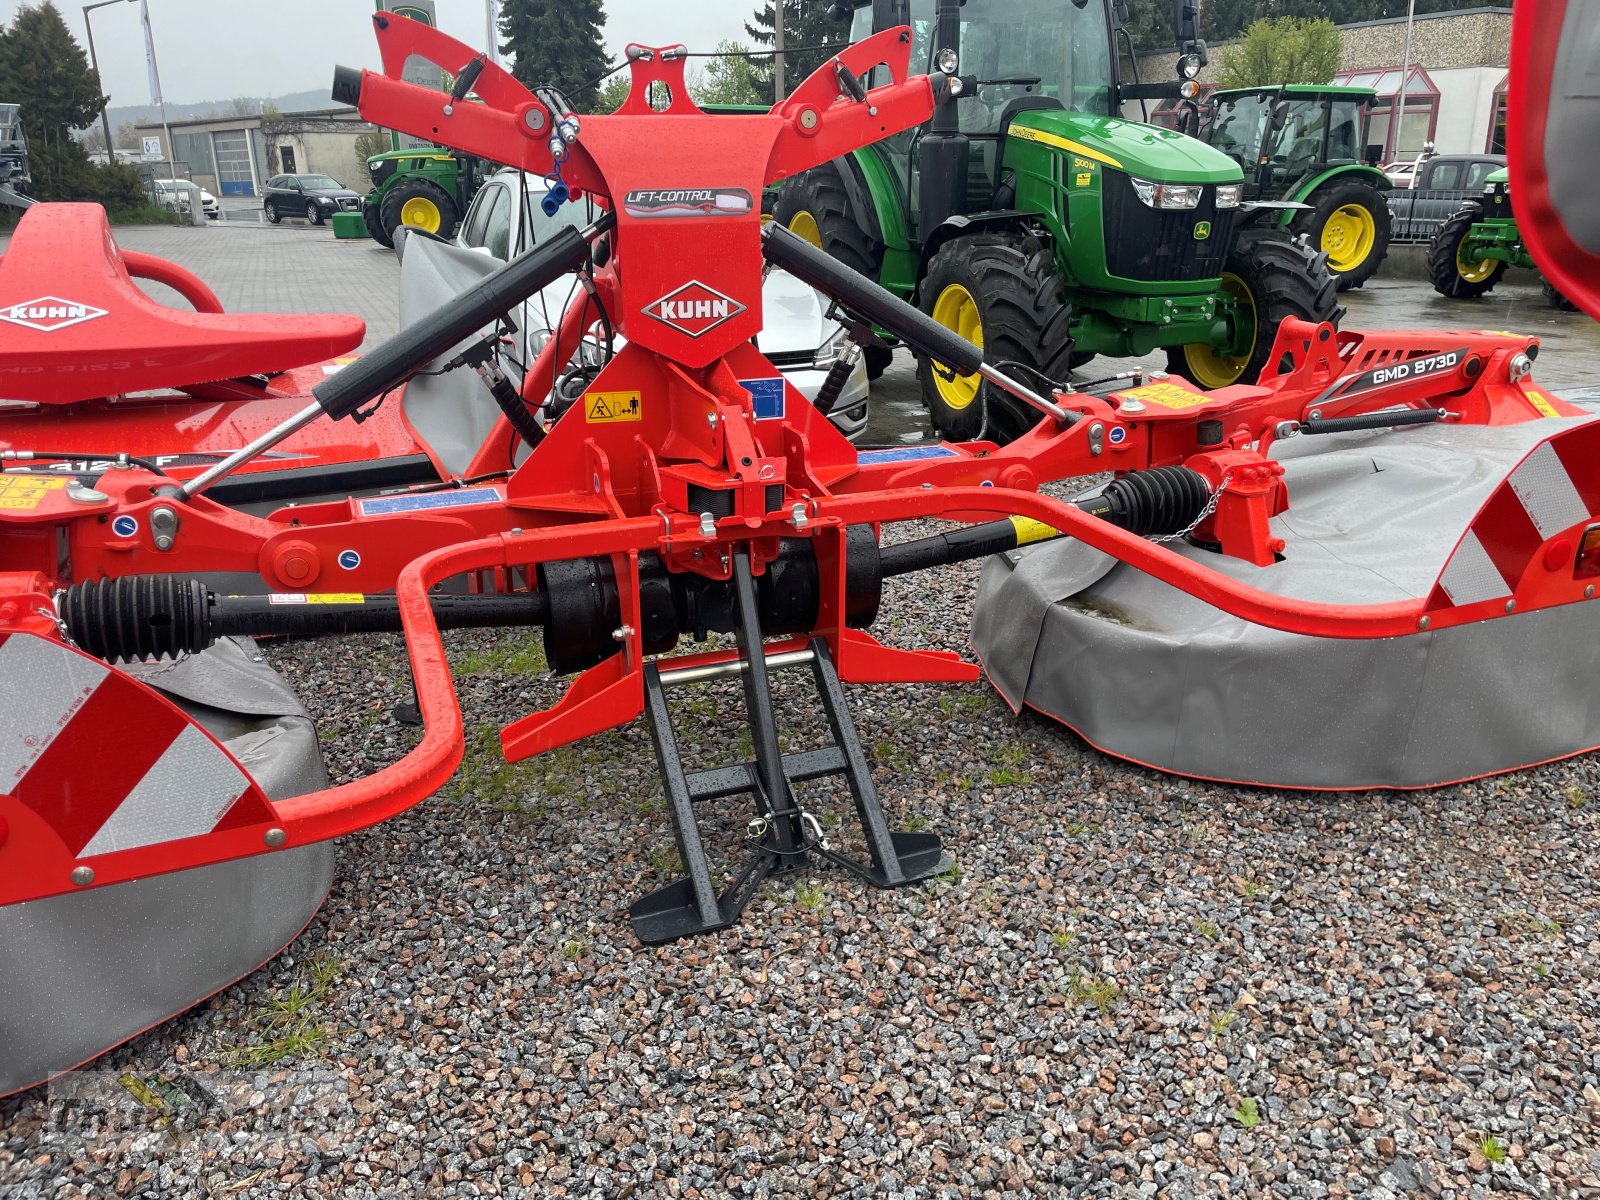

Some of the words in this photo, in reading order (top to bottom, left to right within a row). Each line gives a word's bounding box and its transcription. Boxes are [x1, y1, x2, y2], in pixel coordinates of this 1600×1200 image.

[628, 190, 715, 203] LIFT-CONTROL
[10, 306, 87, 319] KUHN
[661, 299, 729, 319] KUHN
[1373, 365, 1409, 384] GMD
[1414, 352, 1457, 374] 8730
[156, 455, 180, 466] F
